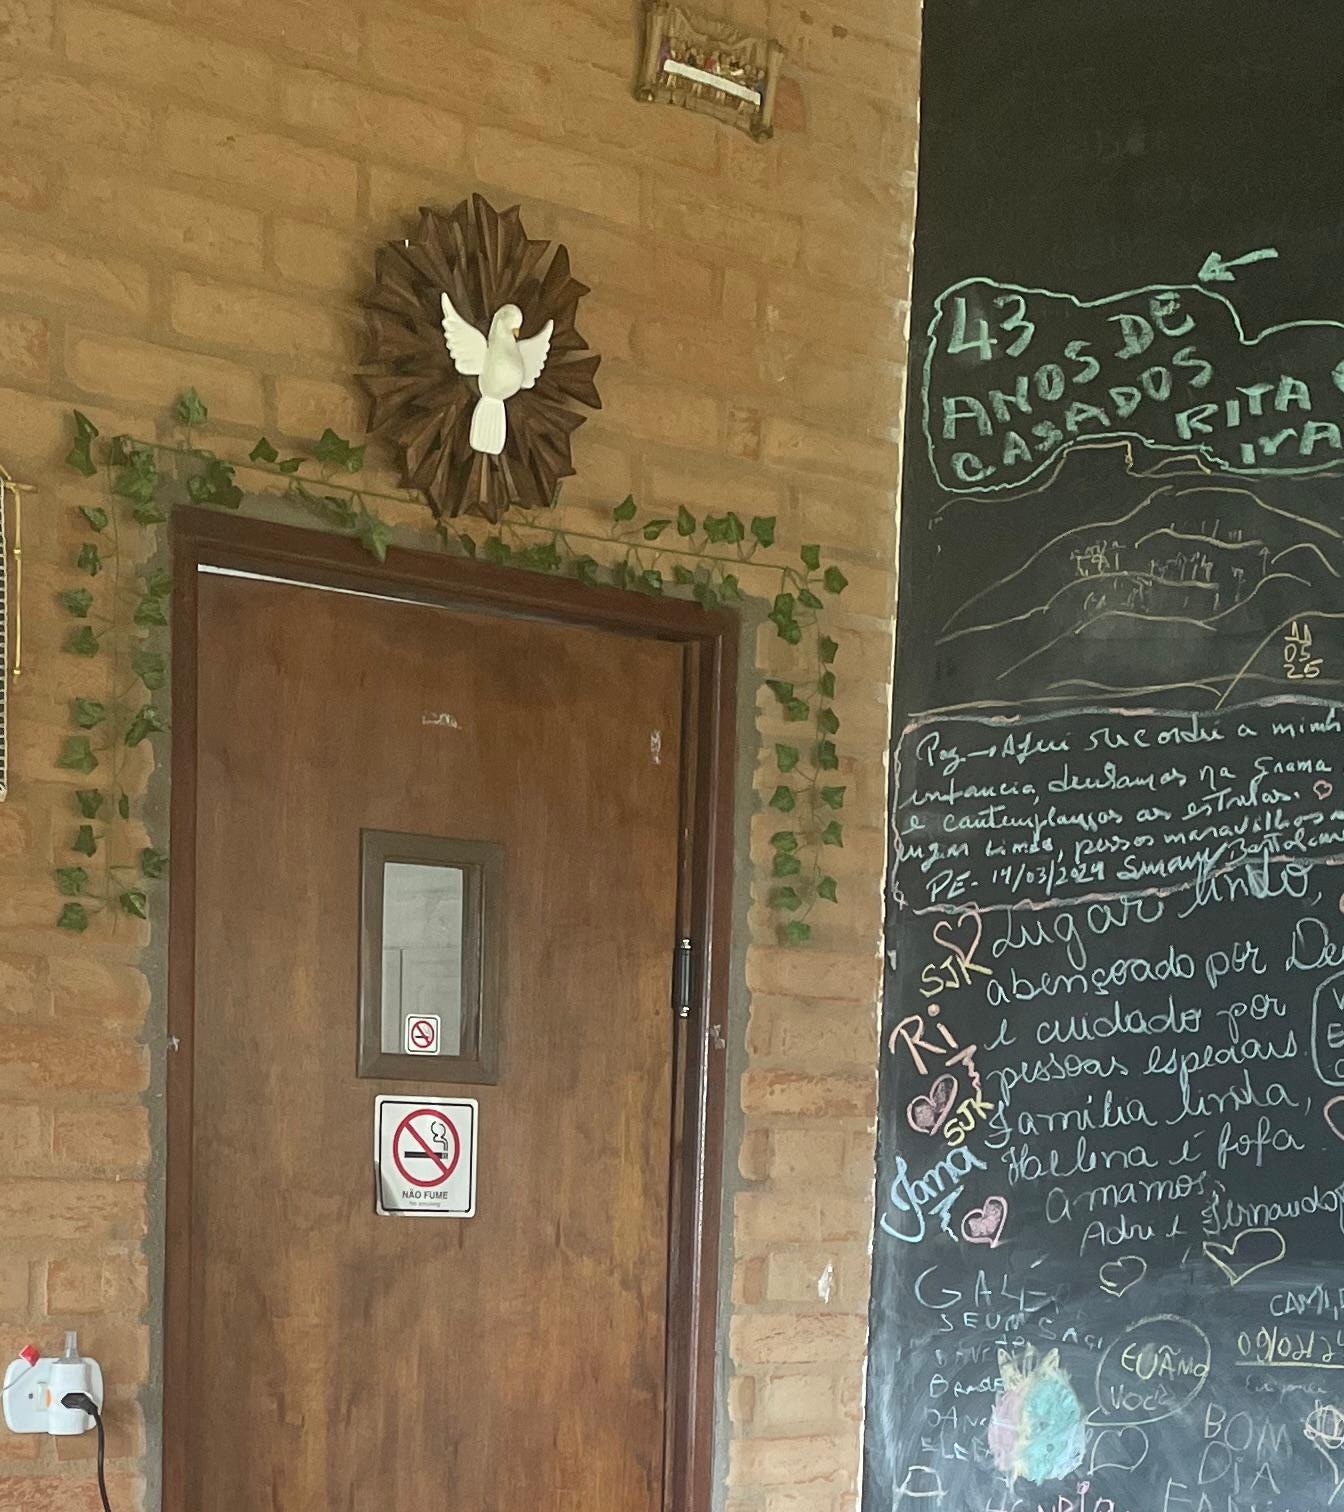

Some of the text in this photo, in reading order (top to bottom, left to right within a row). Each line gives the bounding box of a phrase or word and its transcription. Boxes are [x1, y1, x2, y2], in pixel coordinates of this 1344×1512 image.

[947, 296, 1035, 361] 43
[942, 292, 1196, 439] ANOS DE
[952, 346, 1212, 482] CASADOS
[1174, 375, 1311, 440] RITA
[1286, 661, 1324, 679] 25
[919, 955, 993, 998] SJK
[1206, 940, 1267, 988] por
[1036, 993, 1288, 1046] cuidado por
[1327, 1022, 1344, 1048] E
[987, 1048, 1128, 1106] pessoas
[943, 1093, 993, 1146] SJK
[1218, 1117, 1305, 1170] fofa
[402, 1188, 448, 1199] NÃO FUME
